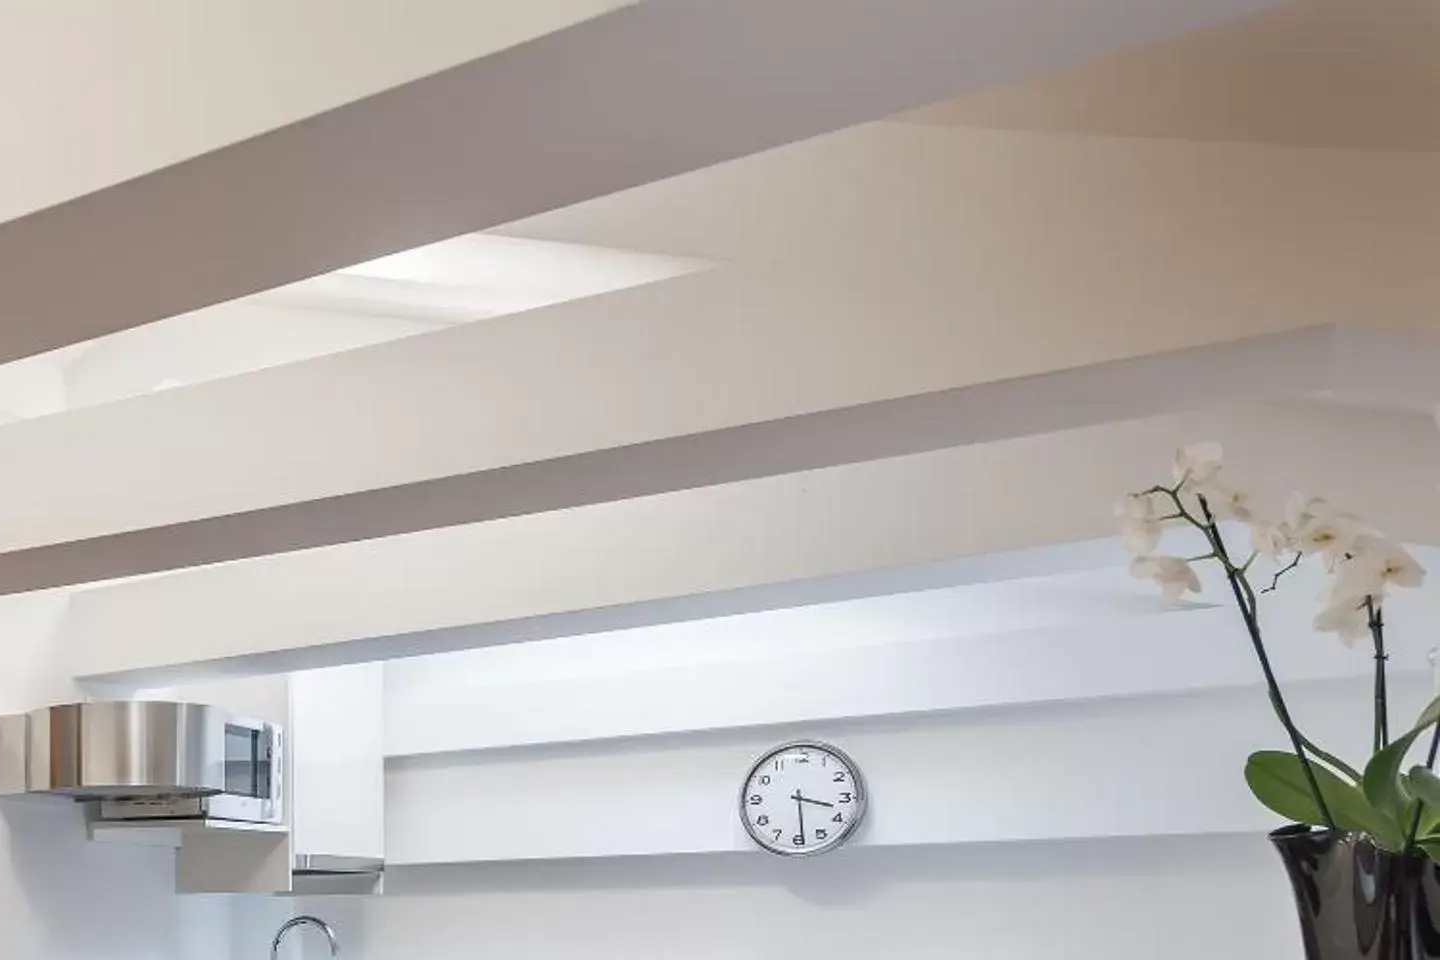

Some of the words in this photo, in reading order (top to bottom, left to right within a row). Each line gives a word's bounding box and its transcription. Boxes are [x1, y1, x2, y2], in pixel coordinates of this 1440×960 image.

[775, 760, 784, 771] 11
[833, 771, 845, 782] 2
[750, 794, 762, 805] 9
[839, 792, 851, 803] 3
[756, 815, 769, 826] 8
[832, 812, 843, 823] 4
[772, 829, 782, 841] 7
[816, 828, 827, 840] 5
[792, 834, 805, 846] 6
